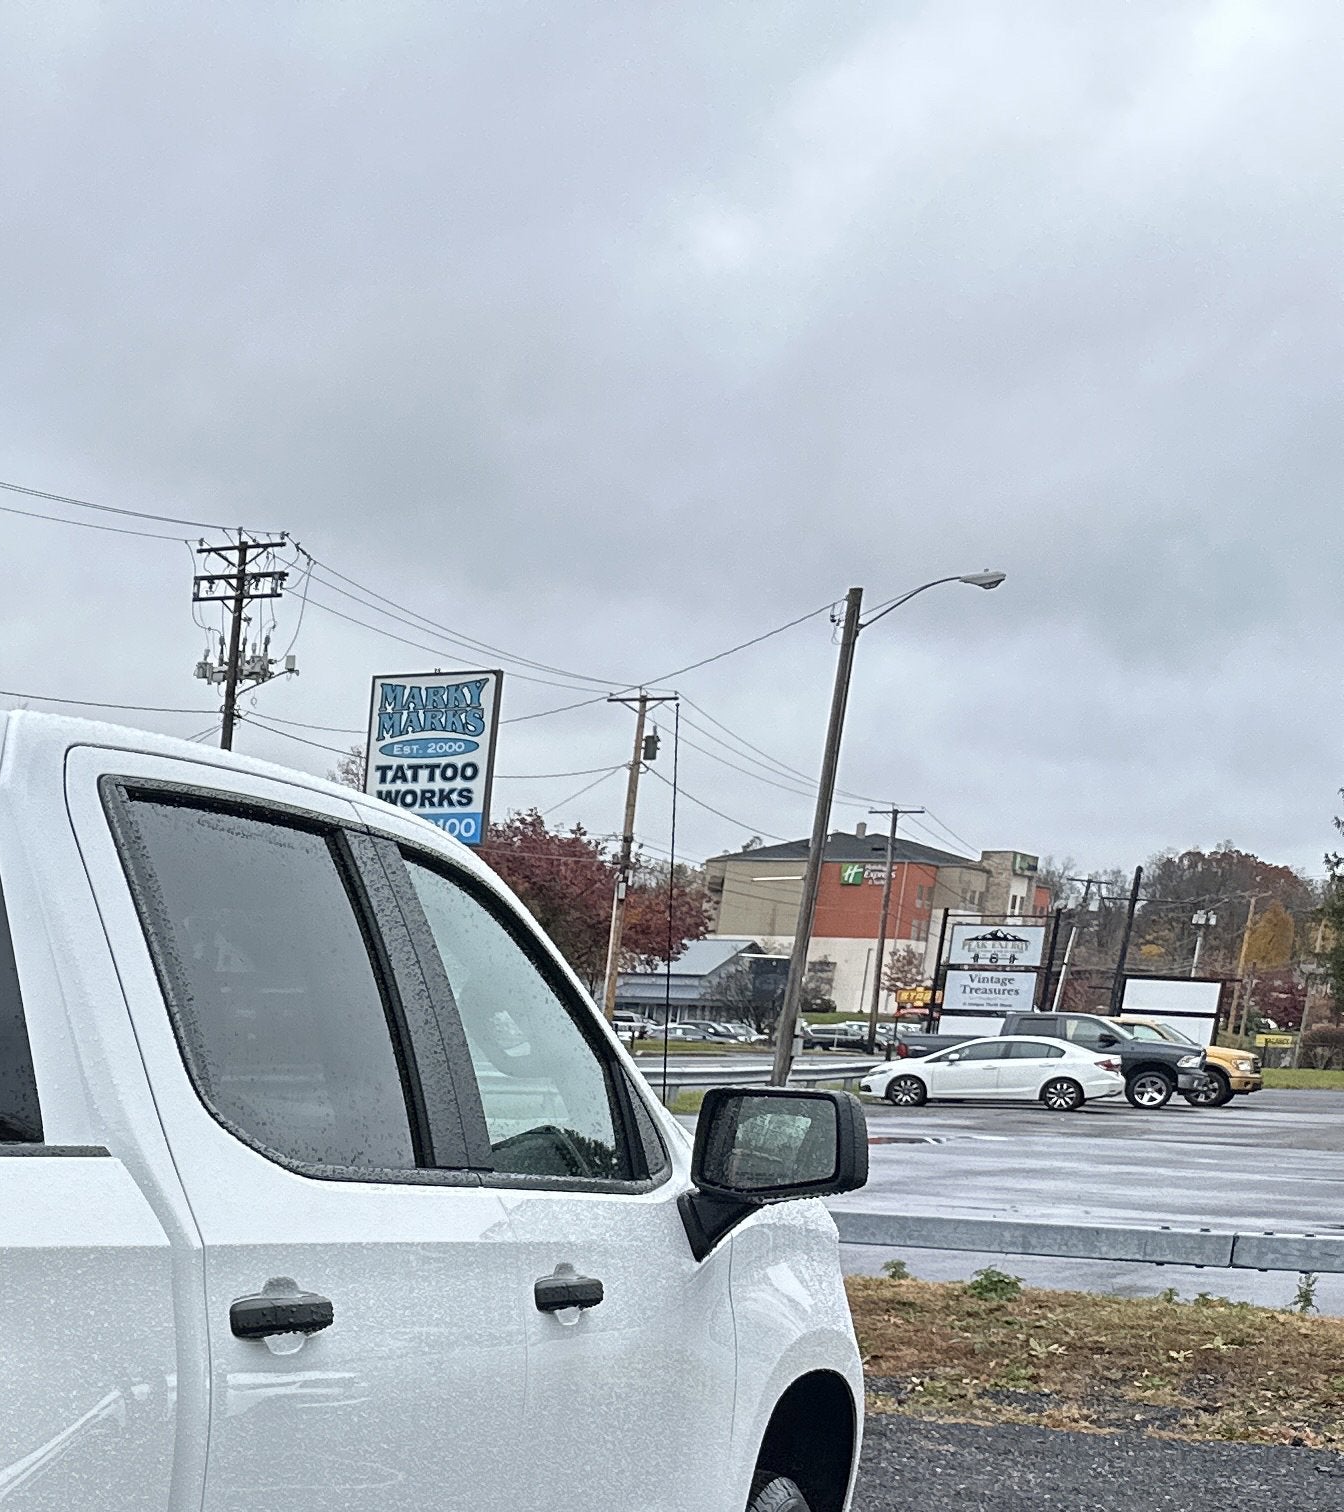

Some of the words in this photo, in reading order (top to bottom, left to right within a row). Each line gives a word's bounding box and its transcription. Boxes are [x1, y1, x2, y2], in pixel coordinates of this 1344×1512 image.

[379, 678, 490, 712] MARKY
[375, 707, 486, 741] MARKS
[426, 742, 466, 754] 2000
[375, 762, 480, 785] TATTOO
[376, 787, 474, 809] WORKS
[960, 984, 1020, 996] Treasures
[969, 974, 1015, 986] Vintage
